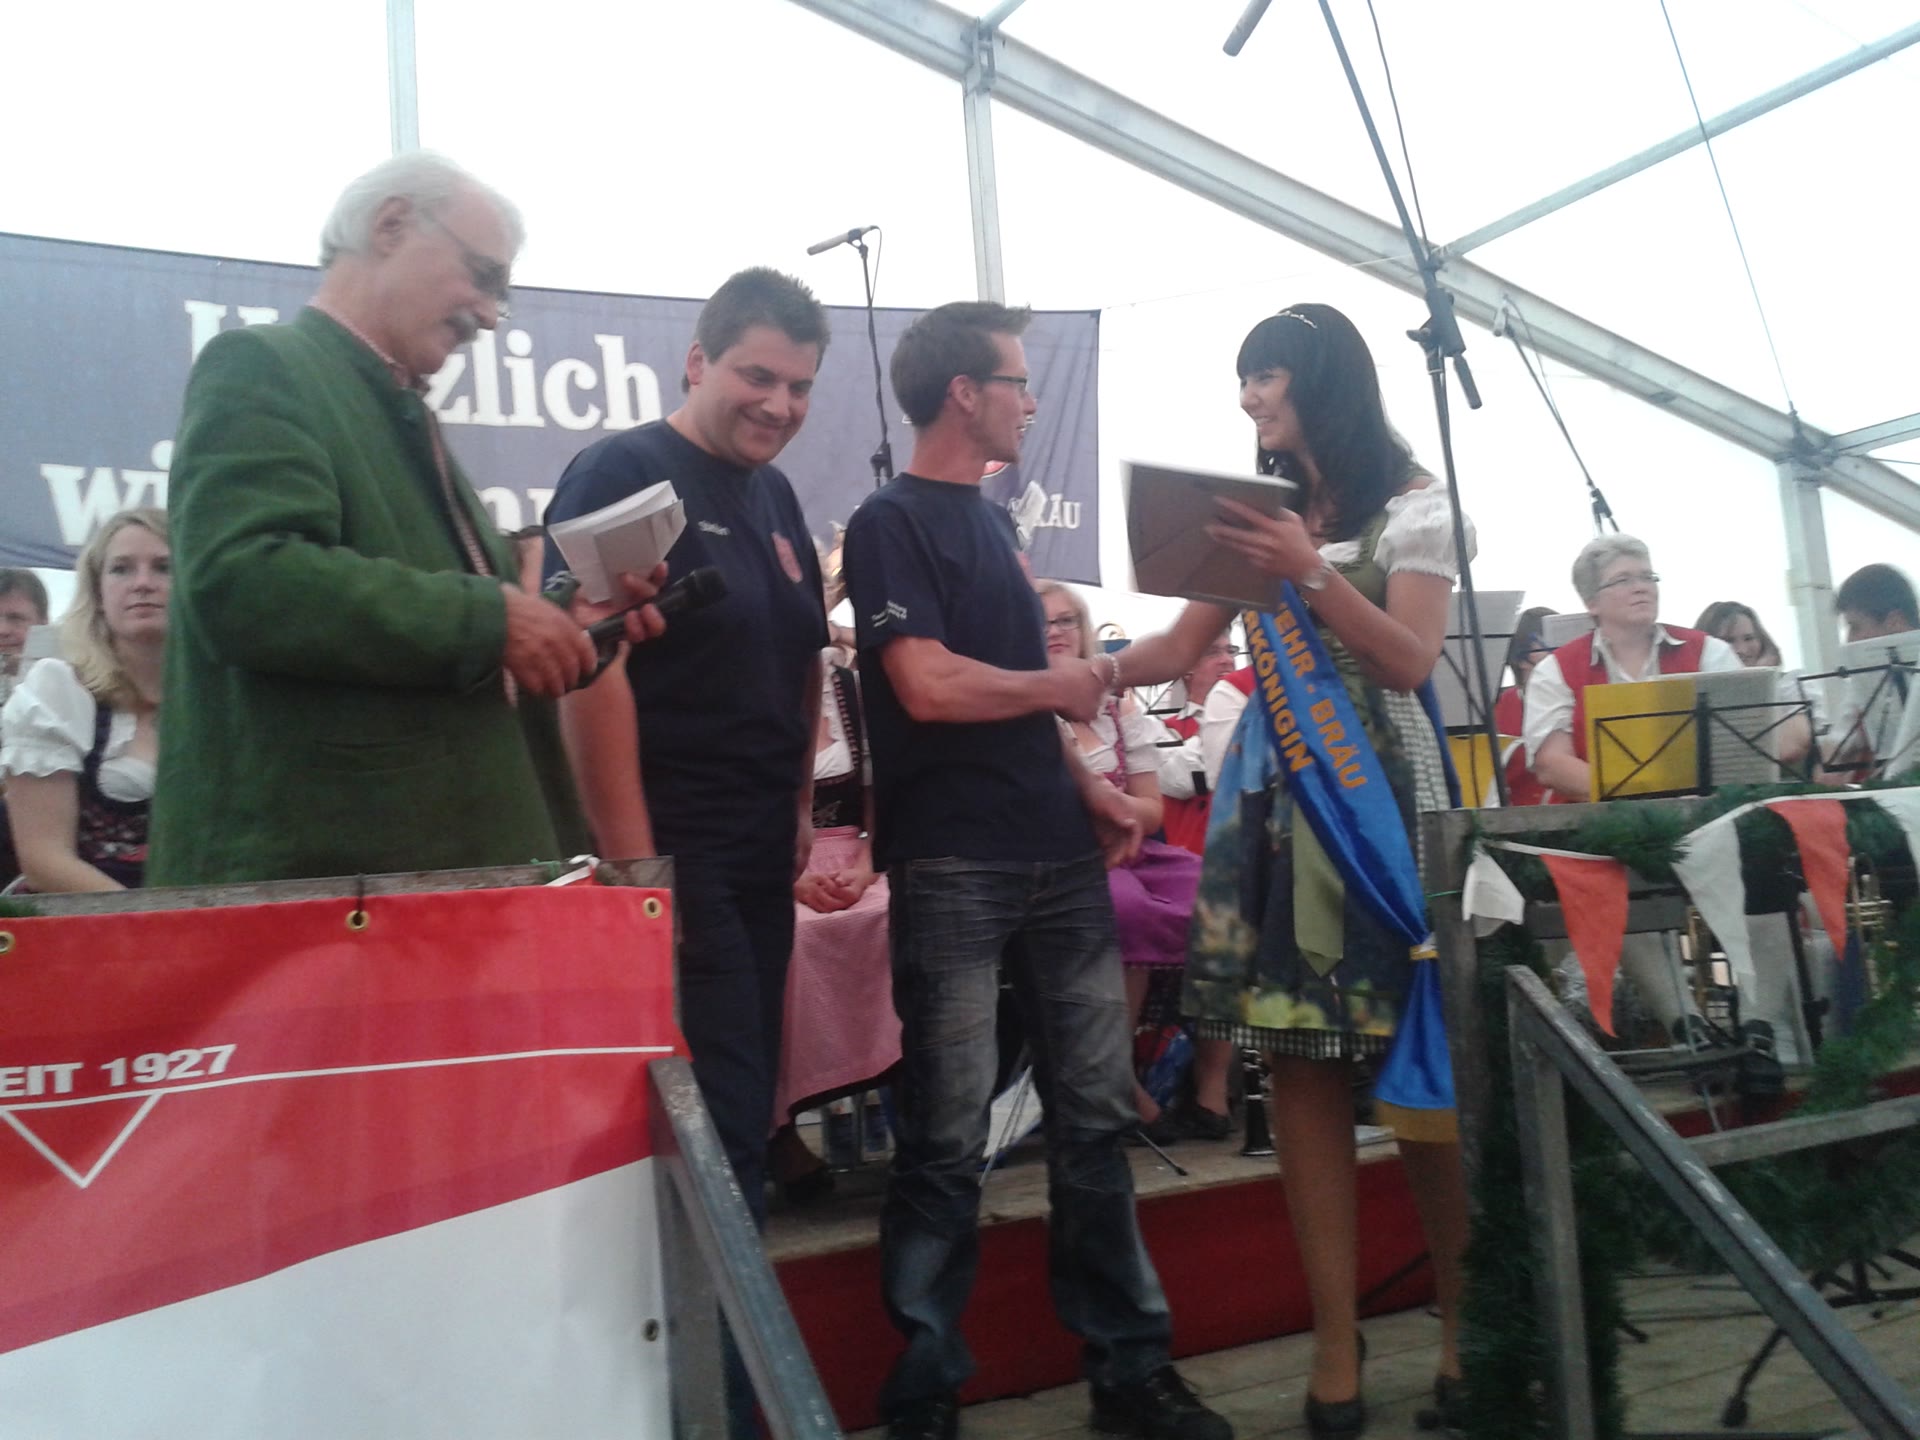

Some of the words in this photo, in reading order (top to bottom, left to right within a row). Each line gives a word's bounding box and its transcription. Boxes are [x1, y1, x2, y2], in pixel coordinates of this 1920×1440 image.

[1274, 603, 1316, 678] EHR
[1309, 698, 1368, 789] BRÄU
[100, 1043, 237, 1087] 1927
